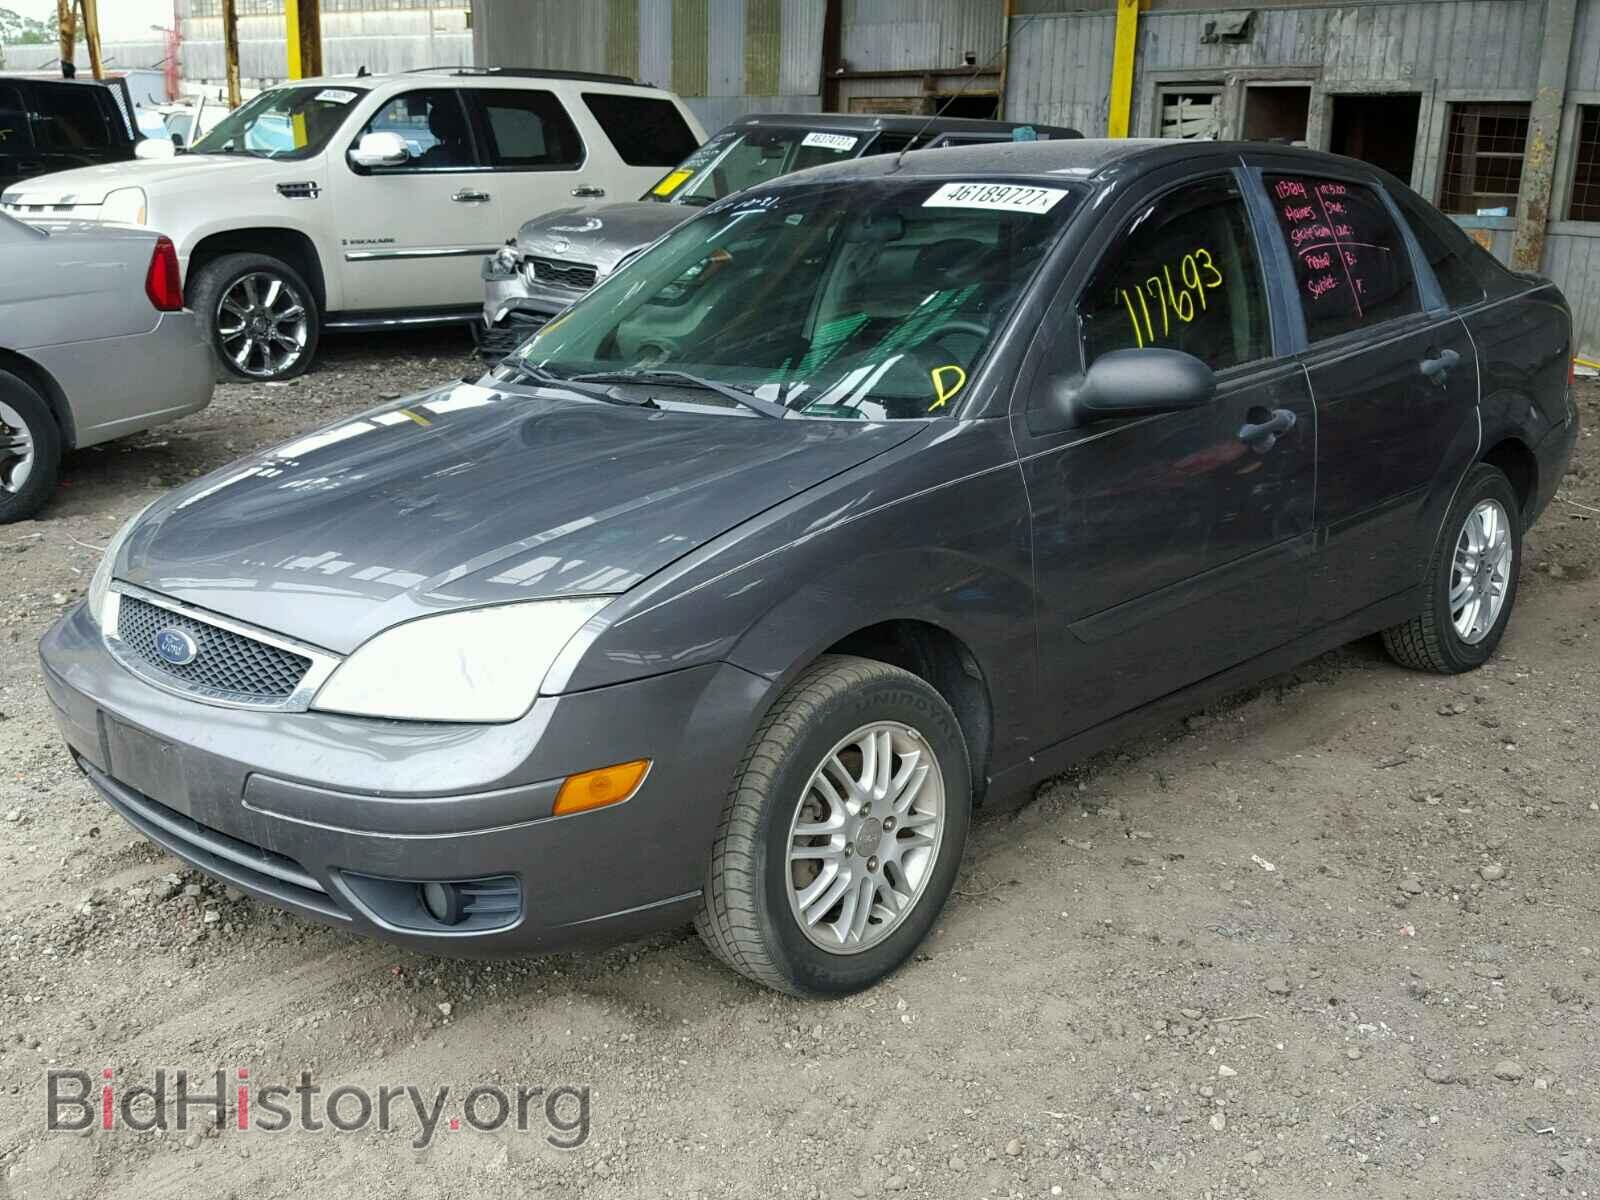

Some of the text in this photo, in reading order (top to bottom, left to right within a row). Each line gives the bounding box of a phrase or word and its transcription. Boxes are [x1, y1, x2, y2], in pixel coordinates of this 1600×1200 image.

[947, 185, 1048, 206] 46189727
[1121, 248, 1222, 350] 117693
[928, 365, 966, 412] D
